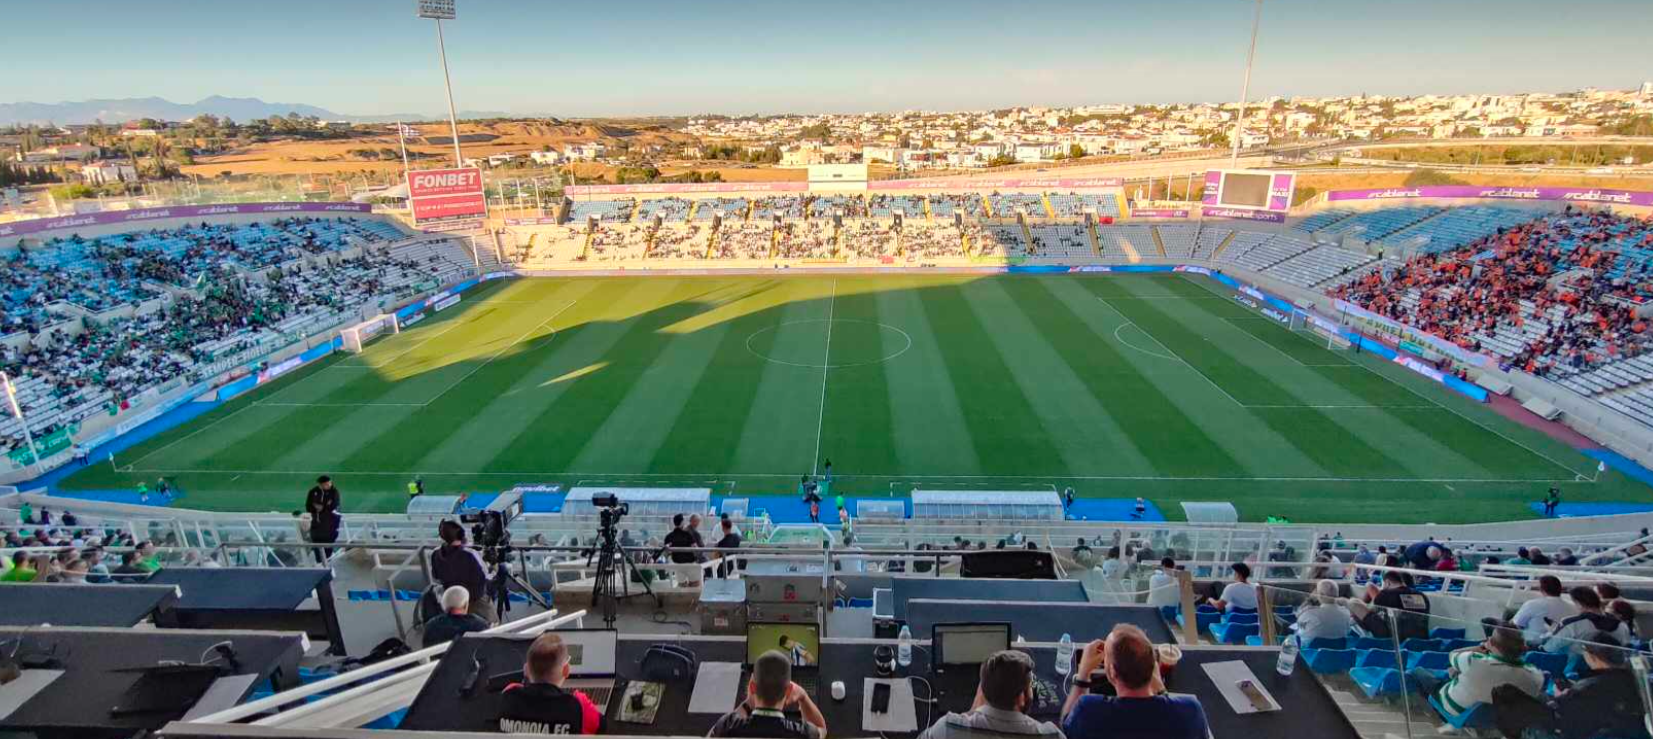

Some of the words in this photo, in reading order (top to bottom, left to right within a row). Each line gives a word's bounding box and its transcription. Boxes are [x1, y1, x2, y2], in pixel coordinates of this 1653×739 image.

[414, 172, 476, 189] FONBET
[500, 717, 549, 735] OMONOIA
[553, 723, 571, 735] FC
